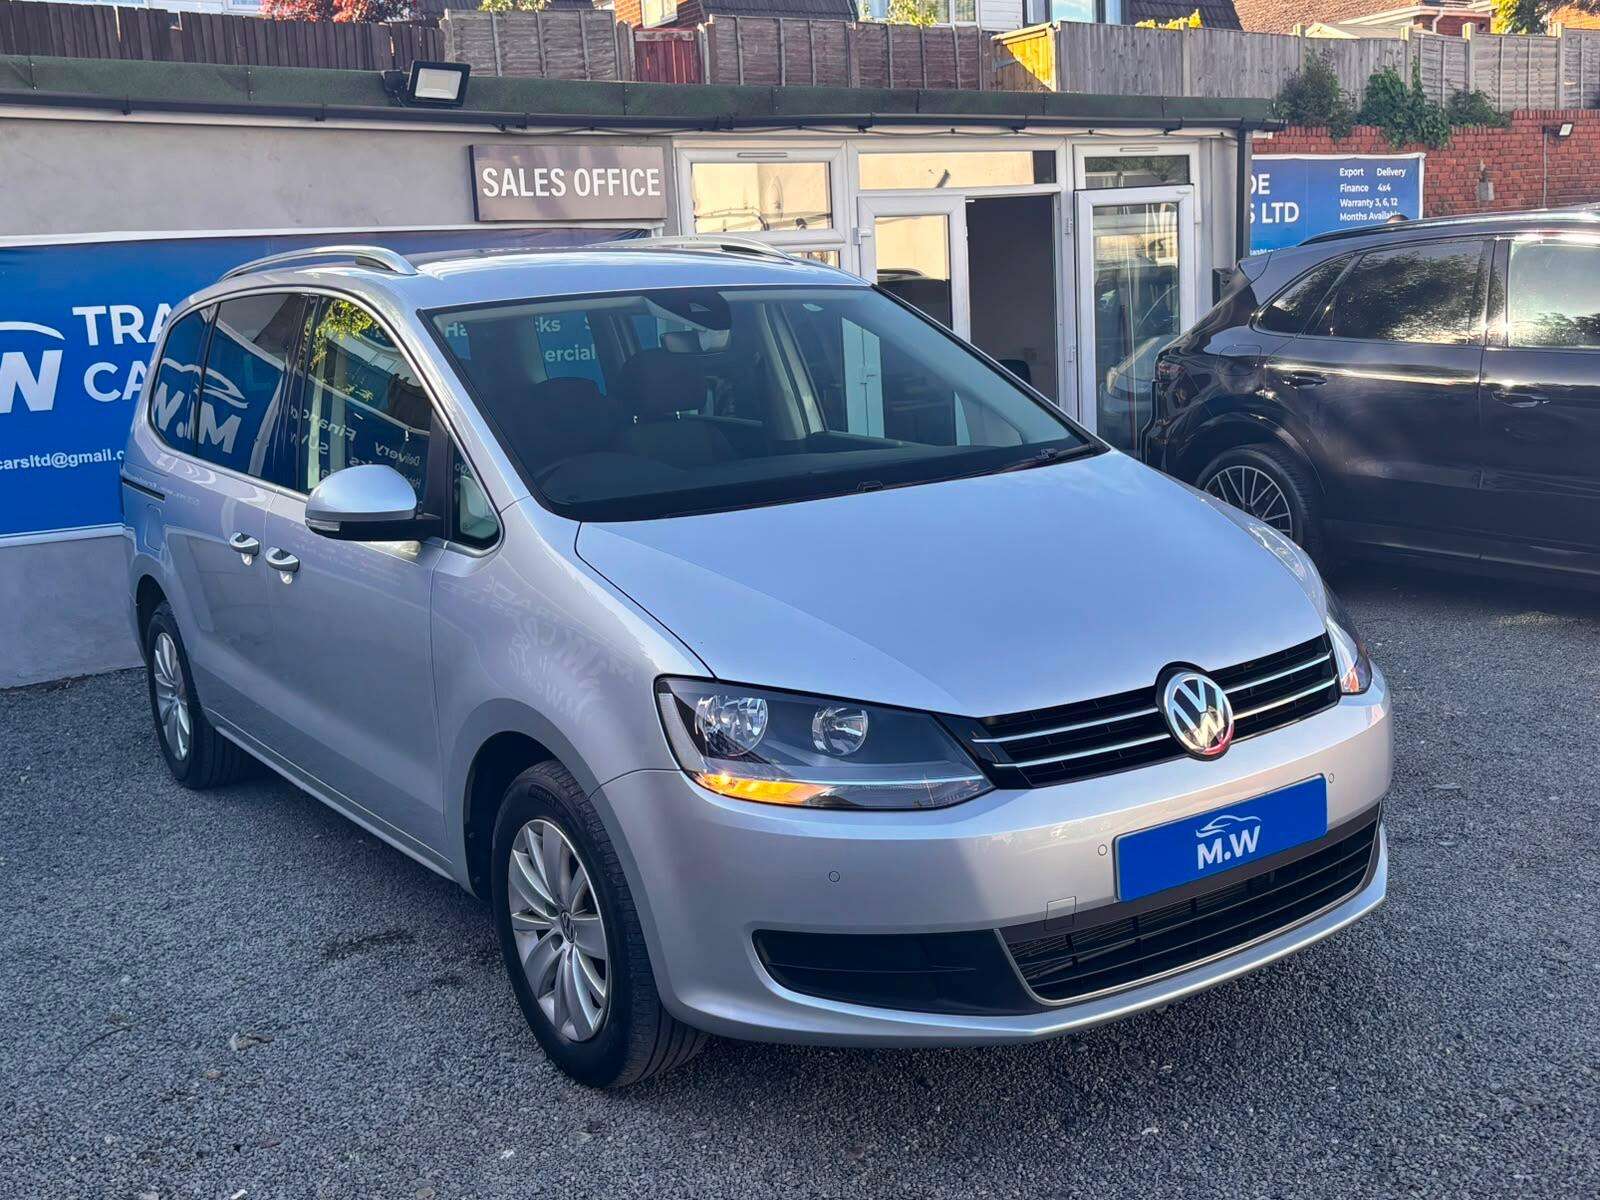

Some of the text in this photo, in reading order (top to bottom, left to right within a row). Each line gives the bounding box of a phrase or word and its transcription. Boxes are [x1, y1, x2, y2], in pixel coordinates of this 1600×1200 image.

[1339, 167, 1364, 178] Export
[1376, 166, 1406, 178] Delivery
[482, 168, 660, 197] SALES OFFICE
[1339, 183, 1369, 193] Finance
[1377, 183, 1391, 192] 4x4
[1339, 197, 1398, 208] Warranty 3, 6, 12
[1262, 201, 1299, 223] LTD
[1339, 210, 1401, 221] Months Availabl
[545, 344, 596, 361] ercial
[1196, 825, 1261, 870] M.W
